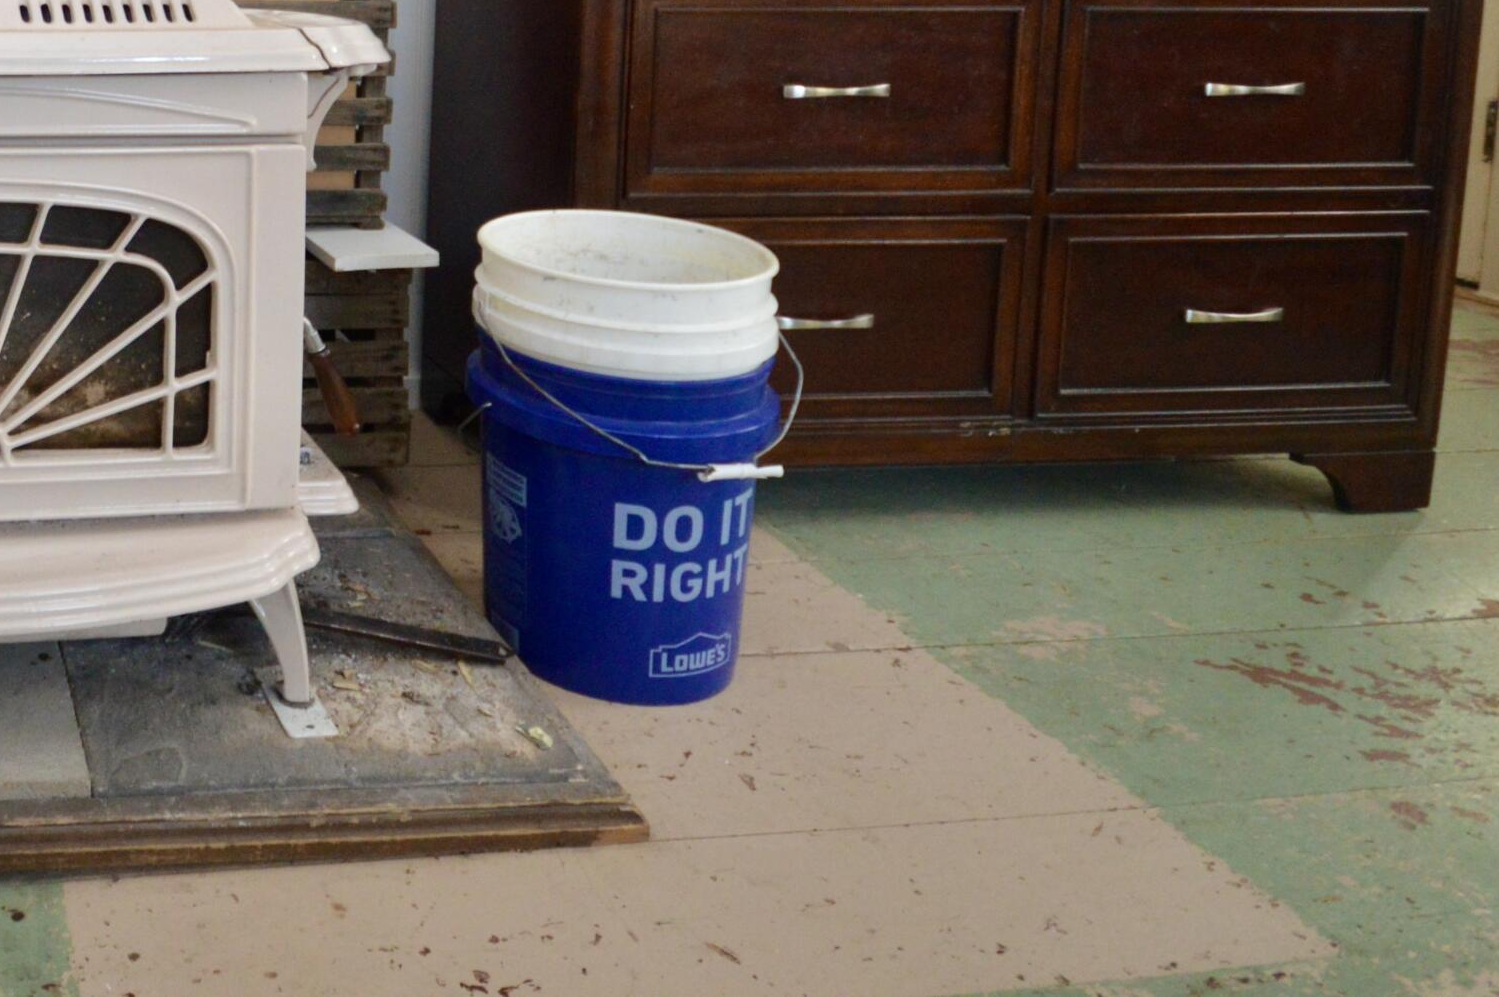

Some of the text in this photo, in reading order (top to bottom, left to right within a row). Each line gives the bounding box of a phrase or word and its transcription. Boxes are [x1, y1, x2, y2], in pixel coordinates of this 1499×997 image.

[612, 487, 754, 553] DO IT
[610, 542, 748, 603] RIGHT
[660, 643, 726, 673] LOWE'S
